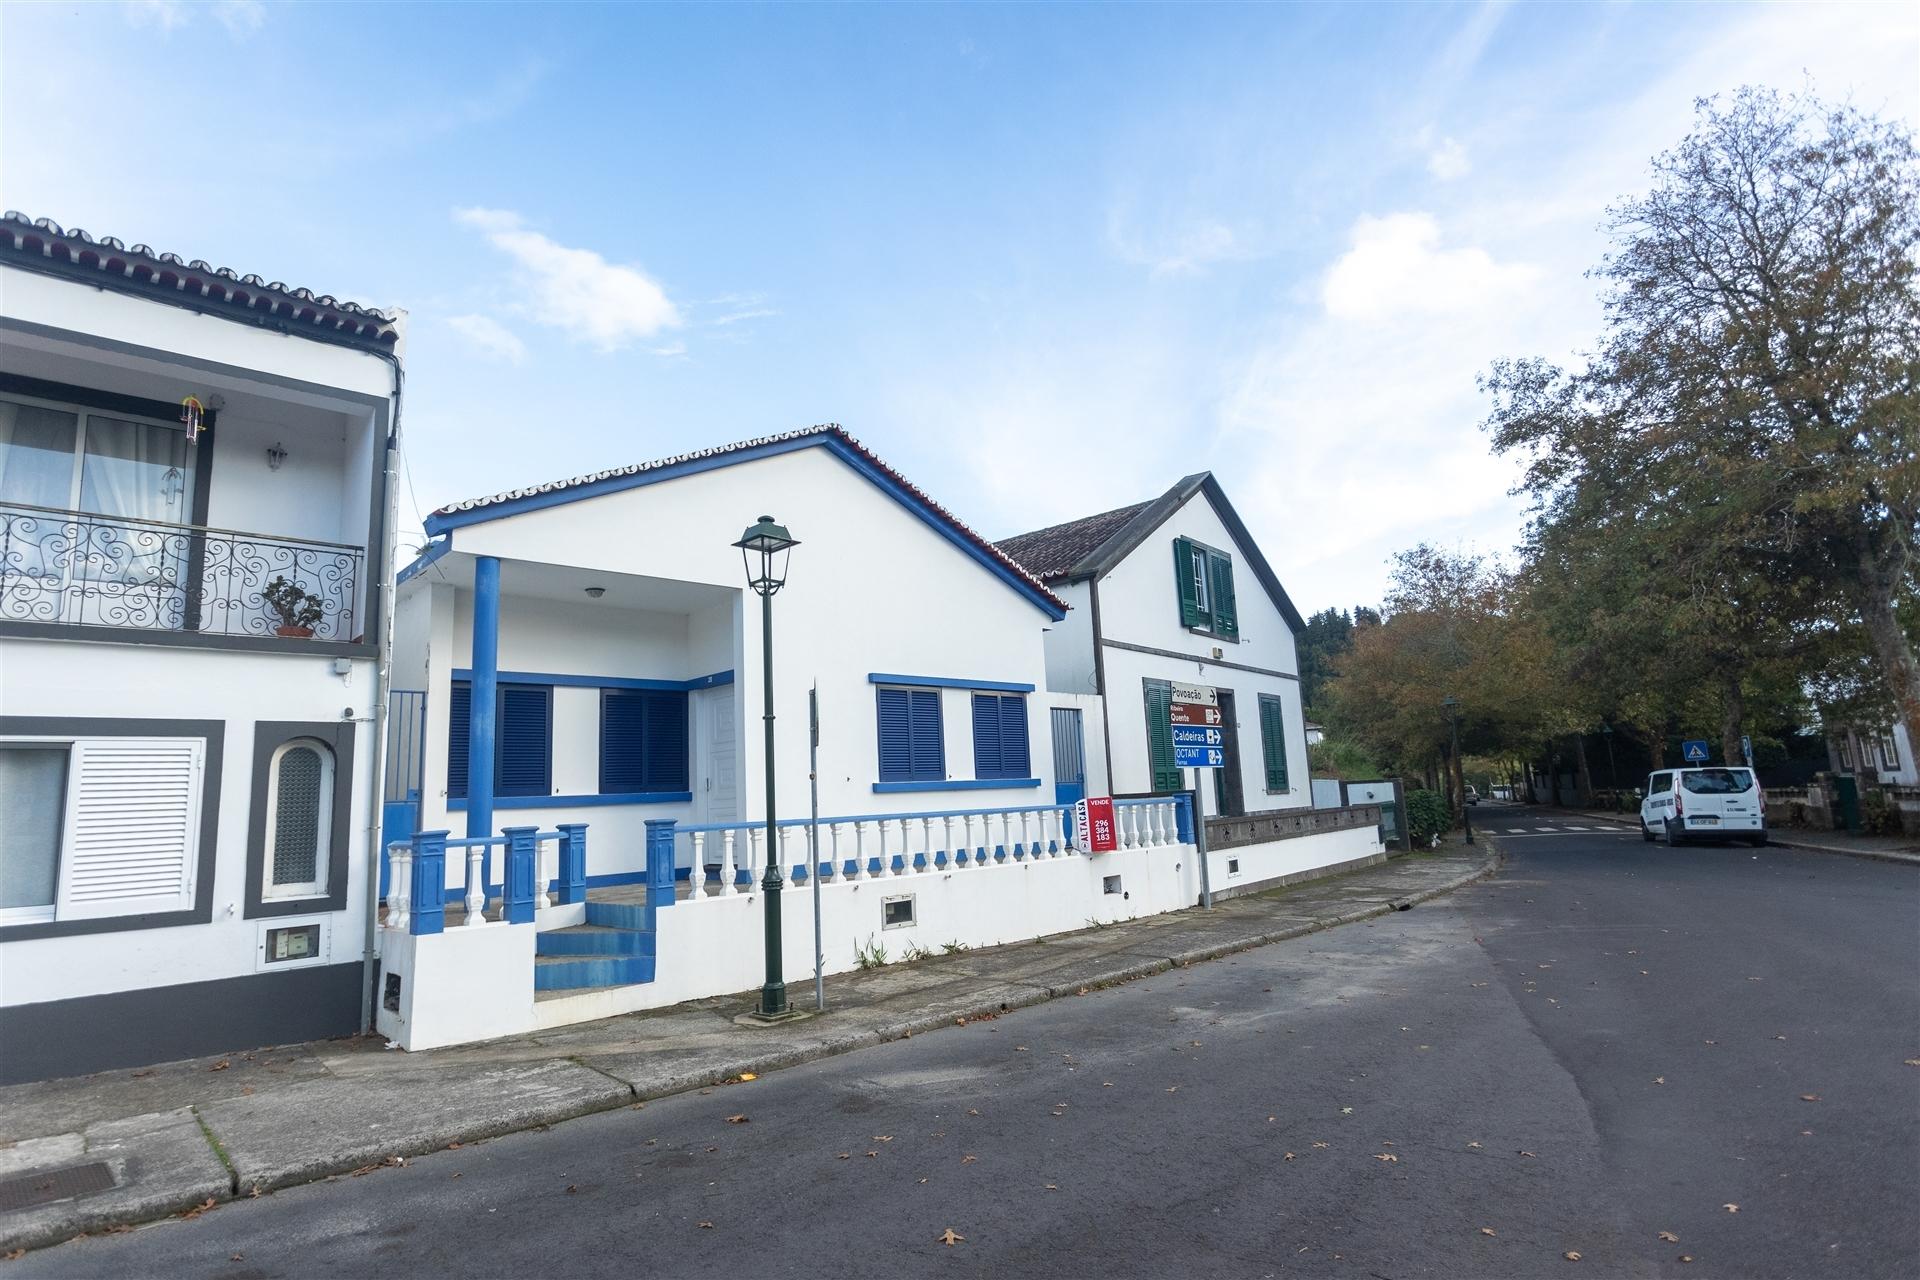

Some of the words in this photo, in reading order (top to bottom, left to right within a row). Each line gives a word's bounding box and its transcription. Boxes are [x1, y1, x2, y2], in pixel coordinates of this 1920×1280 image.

[1172, 687, 1201, 701] Povoação
[1171, 713, 1189, 721] Quente
[1174, 730, 1204, 741] Caldeiras
[1177, 749, 1199, 758] OCTANT
[1078, 802, 1088, 841] ALTACASA
